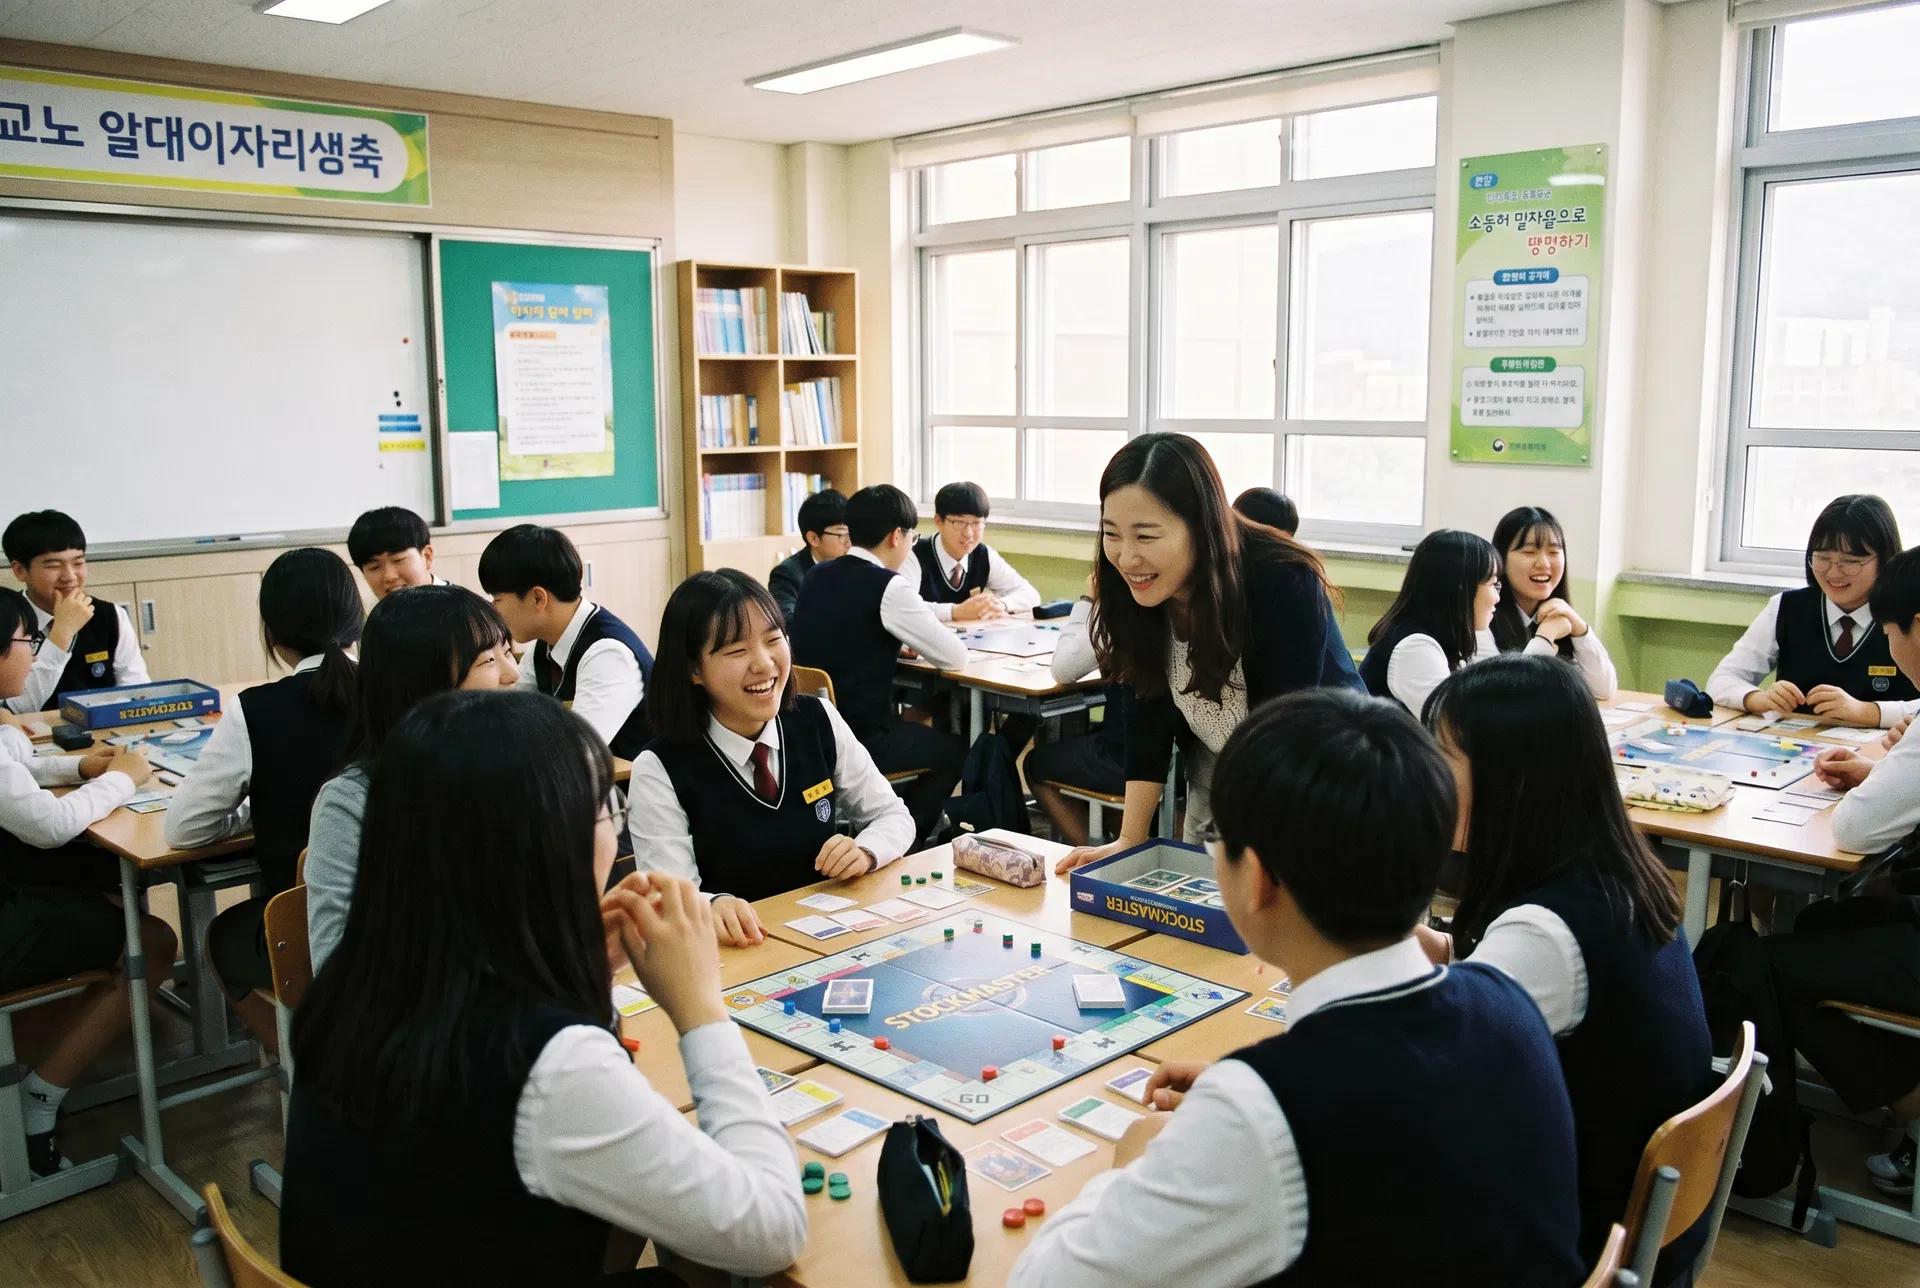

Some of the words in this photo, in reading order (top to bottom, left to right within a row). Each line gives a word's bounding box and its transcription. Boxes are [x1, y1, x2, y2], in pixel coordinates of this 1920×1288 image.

[99, 110, 383, 179] 알대이자리생축
[1106, 895, 1205, 934] STOCKMASTER
[883, 965, 1052, 1030] STOCKMASTER
[960, 1094, 989, 1104] GO
